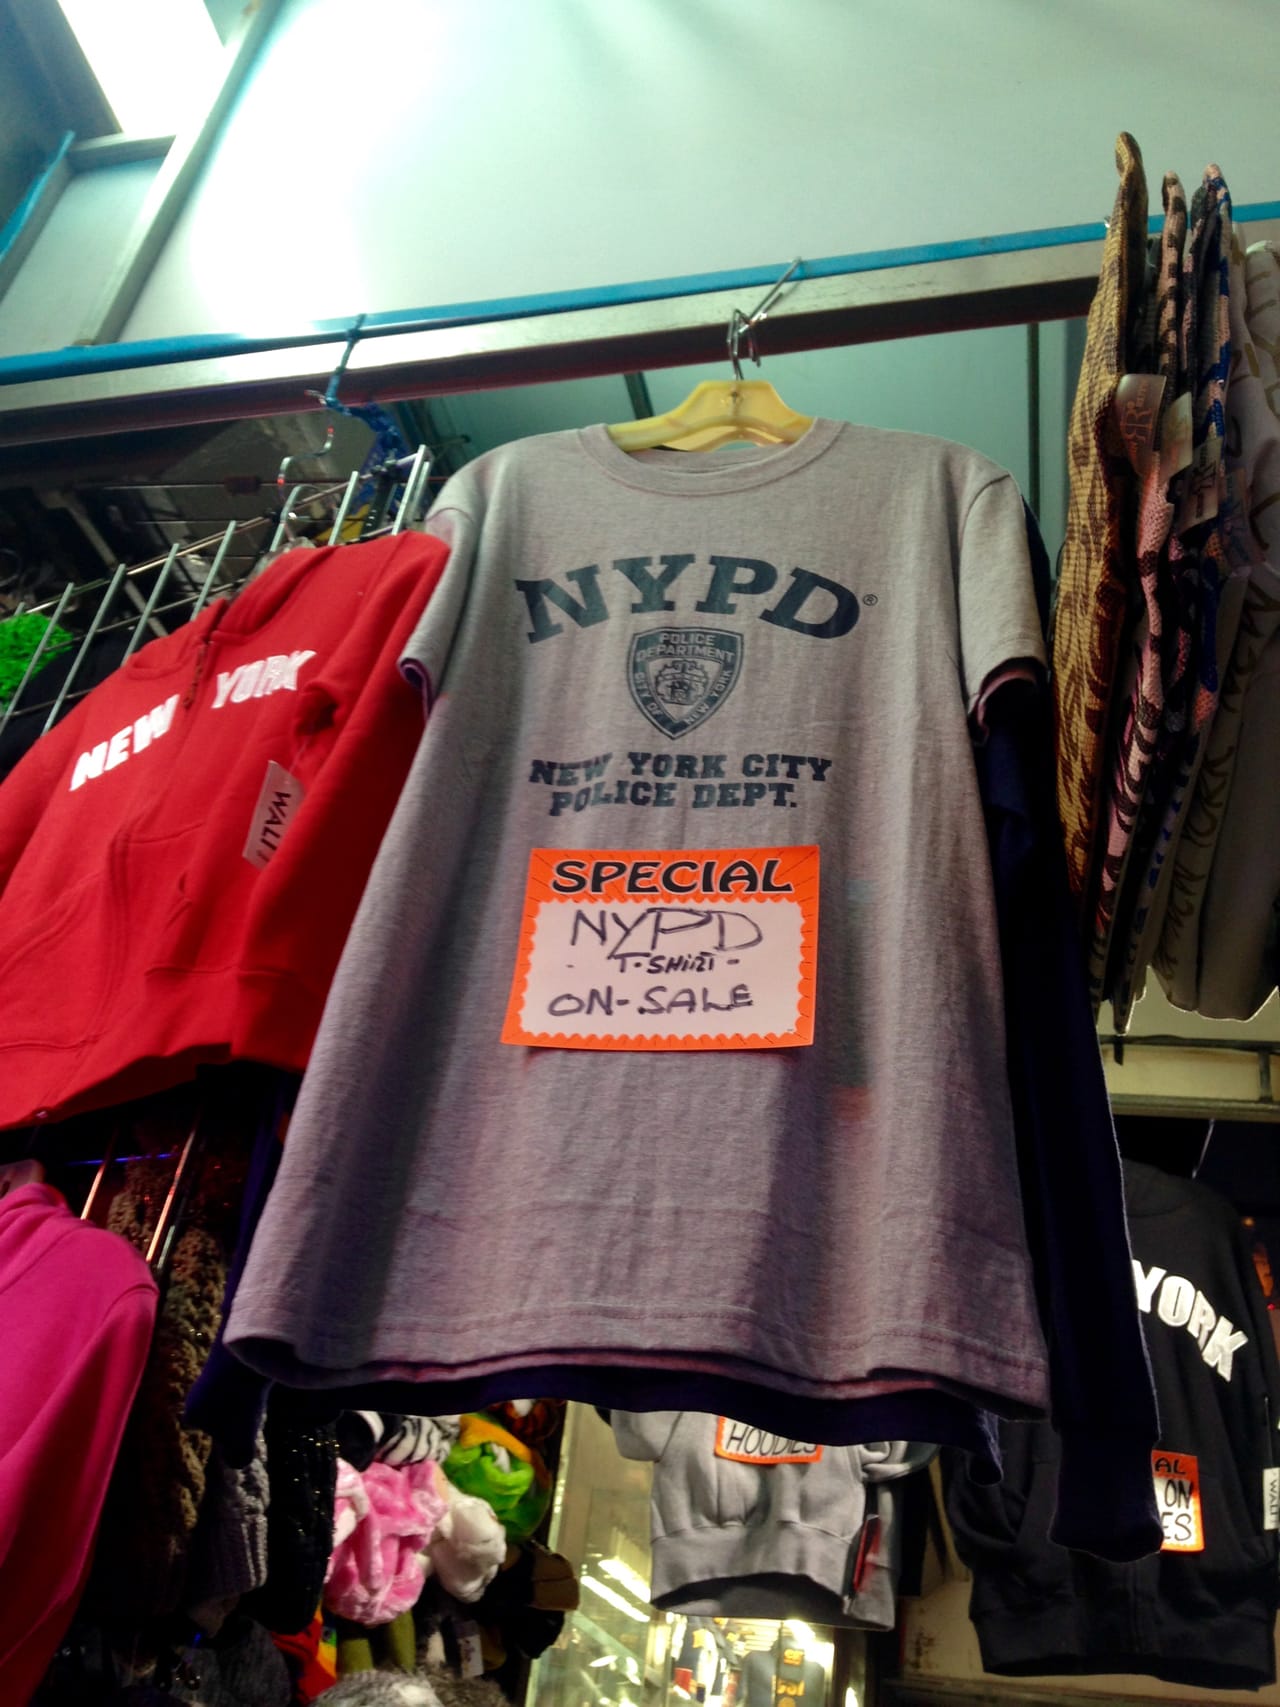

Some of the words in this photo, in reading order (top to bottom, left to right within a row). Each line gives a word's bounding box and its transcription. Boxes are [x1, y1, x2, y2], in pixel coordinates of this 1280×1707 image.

[514, 553, 861, 644] NYPD
[636, 644, 736, 664] DEPARTMENT
[659, 632, 716, 647] POLICE
[710, 669, 733, 698] YORK
[69, 693, 181, 792] NEW
[211, 649, 317, 710] YORK
[528, 752, 613, 786] NEW
[628, 752, 727, 780] YORK
[741, 753, 832, 782] CITY
[549, 780, 678, 817] POLICE
[691, 781, 798, 809] DEPT.
[551, 859, 793, 893] SPECIAL
[570, 906, 764, 960] NYPD
[1131, 1258, 1249, 1383] YORK
[1164, 1479, 1195, 1510] ON
